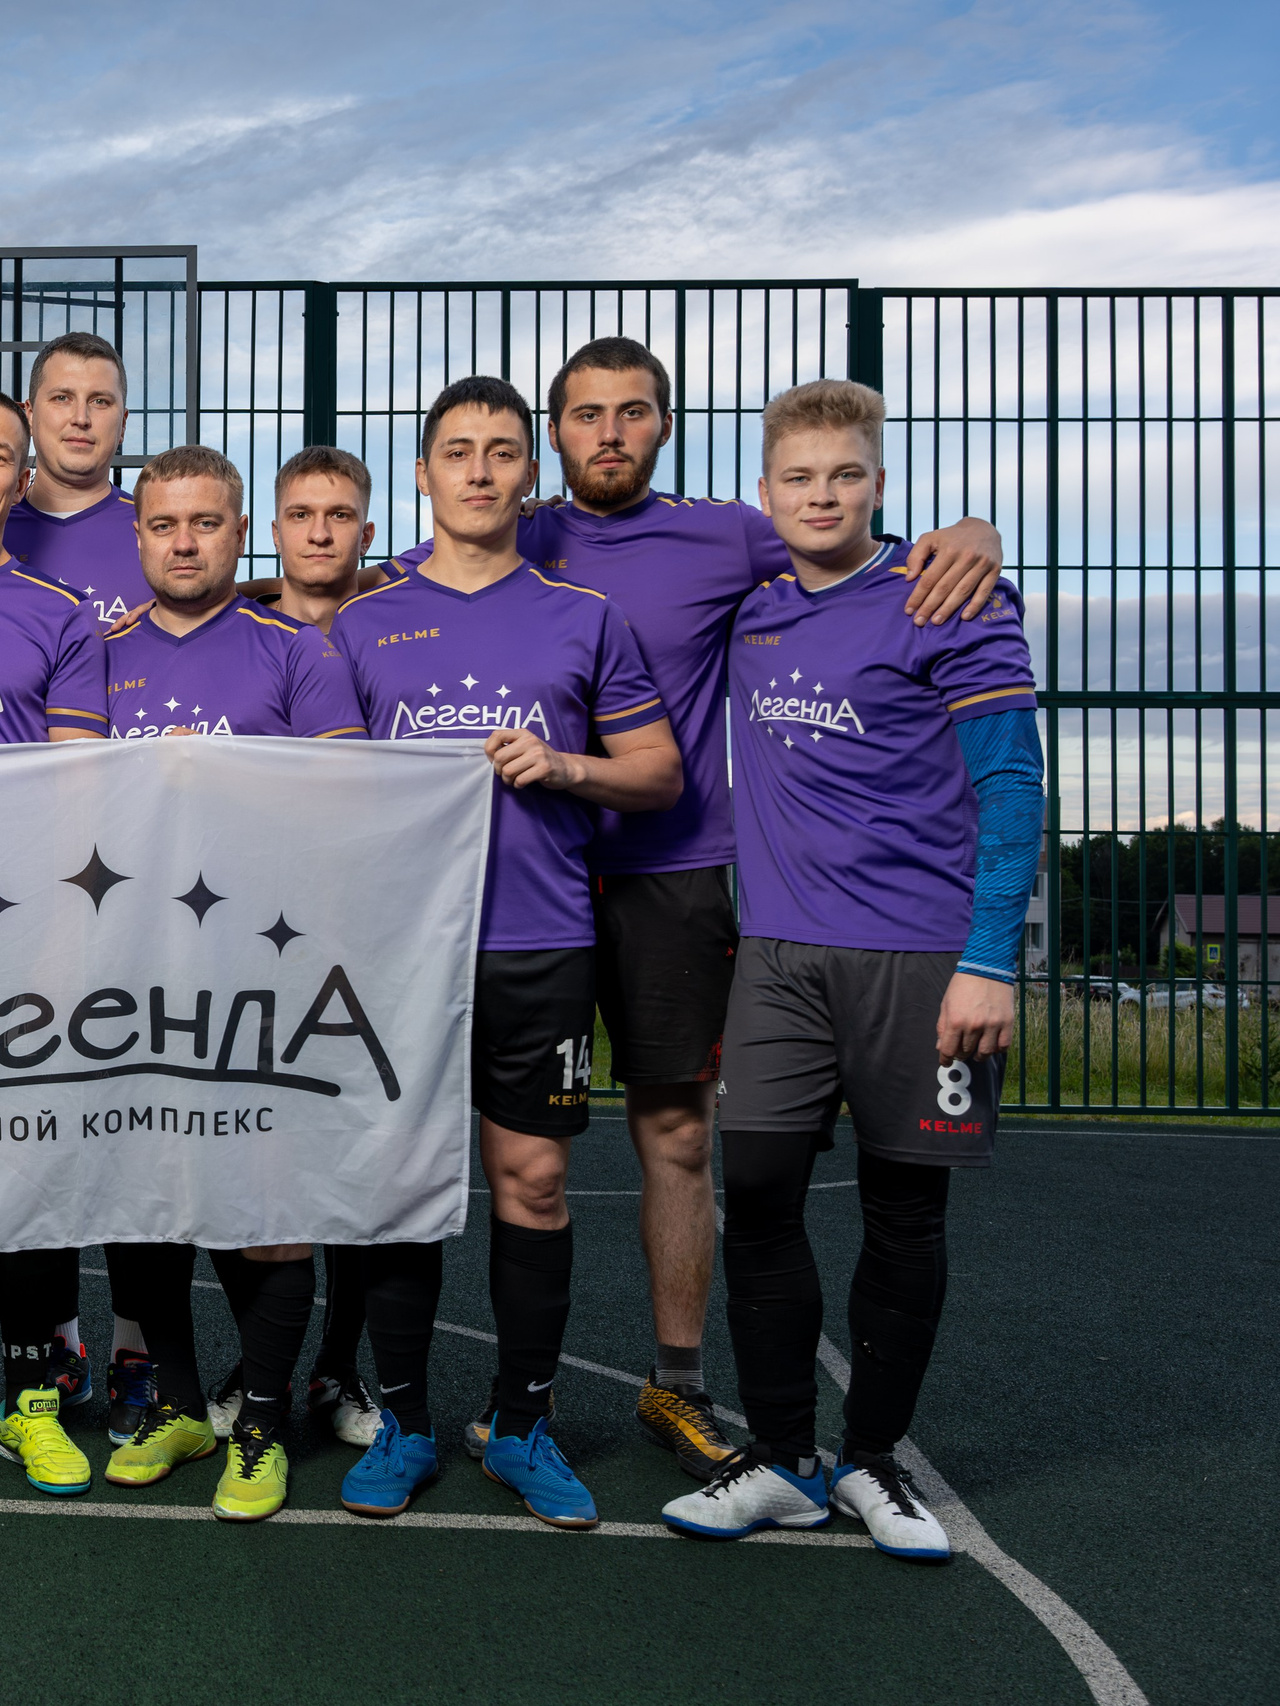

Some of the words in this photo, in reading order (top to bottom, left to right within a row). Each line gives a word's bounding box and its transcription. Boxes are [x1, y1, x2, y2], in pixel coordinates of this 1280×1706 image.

[378, 628, 440, 647] KELME
[743, 635, 781, 645] KELME
[556, 1035, 591, 1090] 14
[937, 1059, 972, 1116] 8
[549, 1092, 587, 1106] KELM
[82, 1106, 273, 1138] КОМПЛЕКС
[919, 1118, 983, 1134] KELME
